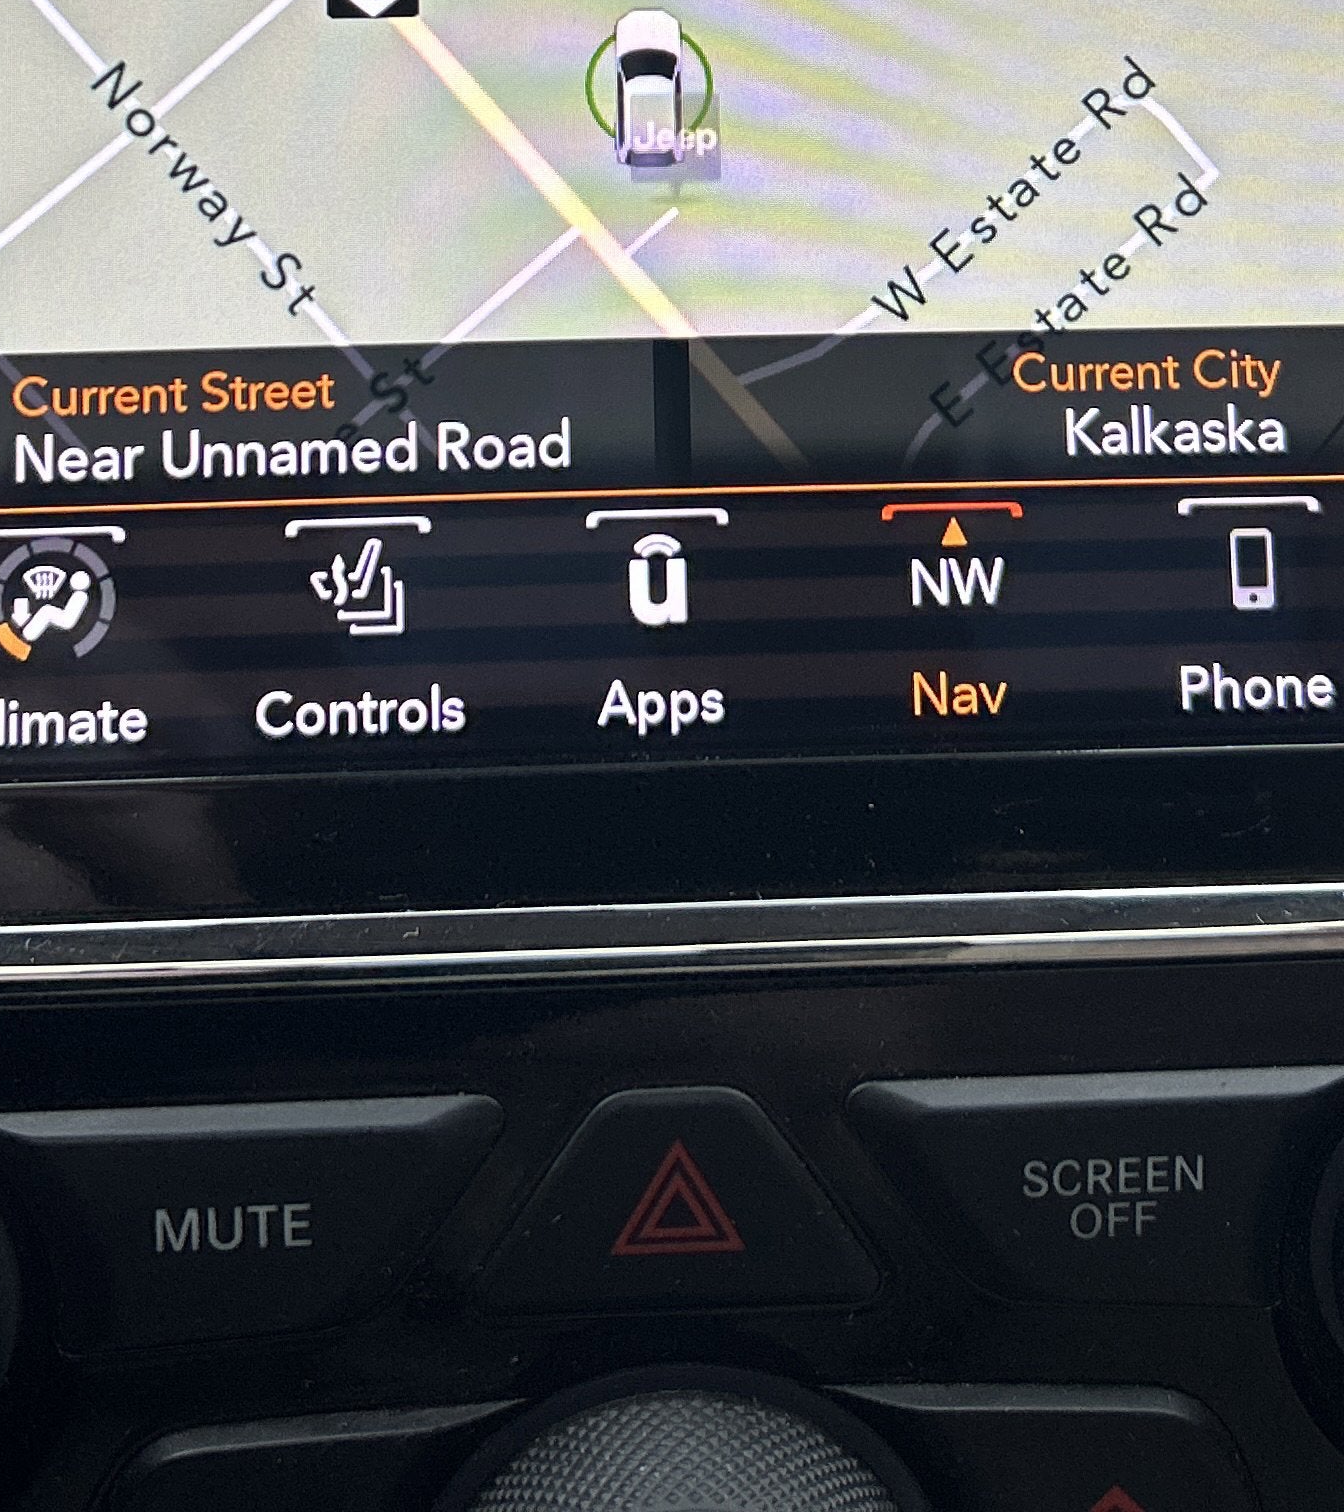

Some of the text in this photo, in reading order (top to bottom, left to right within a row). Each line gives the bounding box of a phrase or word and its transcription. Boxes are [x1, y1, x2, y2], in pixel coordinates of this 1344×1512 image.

[632, 121, 719, 156] Jeep
[92, 61, 314, 316] Norway St
[871, 56, 1156, 324] W Estate Rd
[975, 245, 1131, 386] Estate
[1133, 173, 1208, 247] Rd
[12, 371, 336, 419] Current Street
[1012, 348, 1281, 398] Current City
[15, 433, 145, 484] Near
[162, 420, 418, 480] Unnamed
[437, 418, 571, 472] Road
[1065, 405, 1288, 456] Kalkaska
[910, 556, 1004, 606] NW
[256, 683, 466, 737] Controls
[598, 680, 725, 736] Apps
[911, 671, 1007, 717] Nav
[1180, 663, 1336, 711] Phone
[1022, 1154, 1206, 1199] SCREEN
[155, 1203, 314, 1254] MUTE
[1070, 1202, 1158, 1240] OFF
